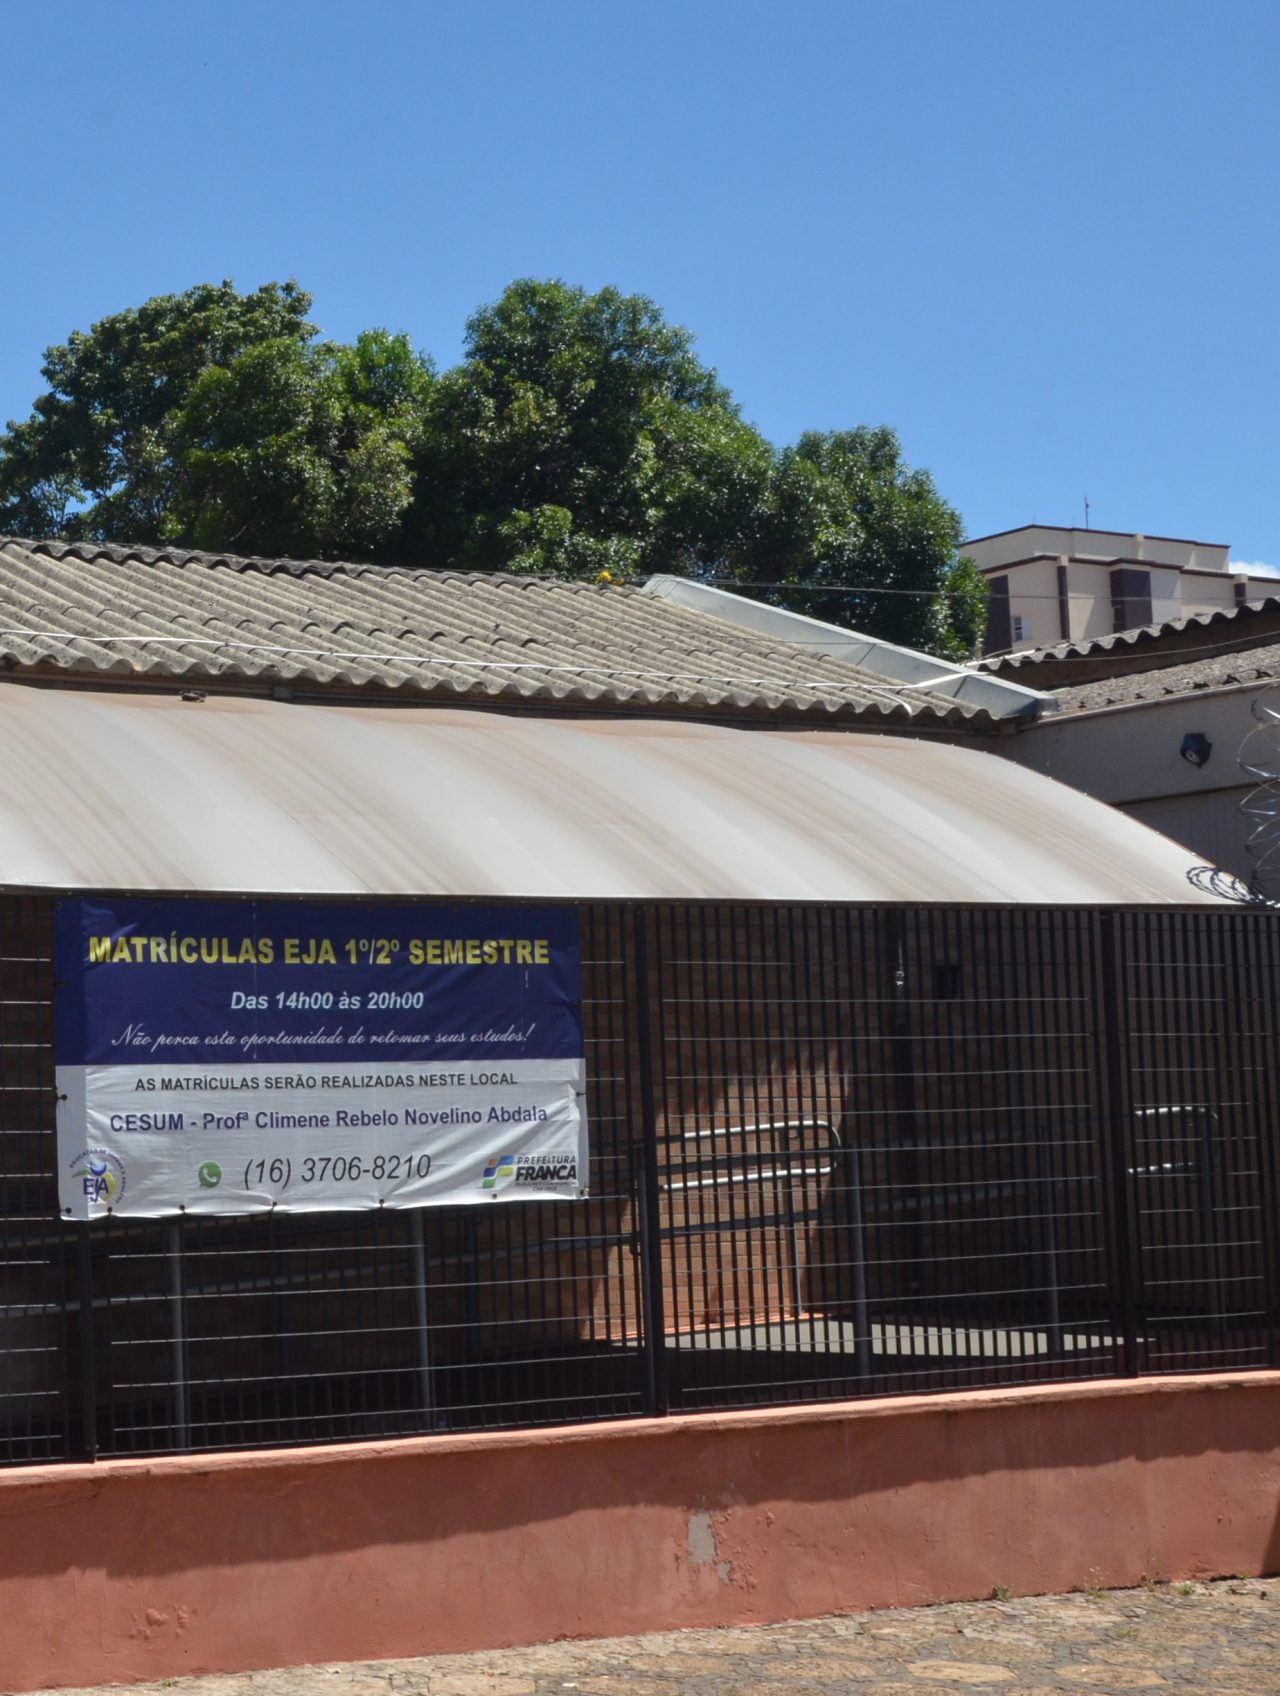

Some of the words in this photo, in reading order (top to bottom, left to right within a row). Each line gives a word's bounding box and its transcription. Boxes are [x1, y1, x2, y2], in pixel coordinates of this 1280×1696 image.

[88, 931, 275, 964] MATRÍCULAS
[285, 938, 336, 965] EJA
[408, 938, 550, 966] SEMESTRE
[230, 991, 269, 1010] Das
[275, 991, 334, 1010] 14h00
[338, 990, 361, 1010] às
[367, 991, 424, 1009] 20h00
[111, 1023, 152, 1047] Não
[151, 1033, 200, 1053] perca
[204, 1029, 236, 1046] esta
[240, 1026, 344, 1052] oportunidade
[347, 1027, 365, 1046] de
[369, 1029, 432, 1045] retomar
[434, 1032, 467, 1044] seus
[470, 1023, 536, 1043] estudos!
[134, 1077, 157, 1092] AS
[161, 1073, 260, 1092] MATRÍCULAS
[265, 1072, 317, 1090] SERÃO
[320, 1074, 415, 1089] REALIZADAS
[419, 1073, 465, 1087] NESTE
[470, 1071, 518, 1086] LOCAL
[110, 1112, 185, 1133] CESUM
[255, 1109, 330, 1129] Climene
[336, 1107, 399, 1127] Rebelo
[404, 1105, 482, 1126] Novelino
[487, 1103, 548, 1123] Abdala
[243, 1157, 292, 1190] (16)
[300, 1153, 432, 1184] 3706-8210
[517, 1155, 576, 1165] PREFEITURA
[515, 1165, 576, 1181] FRANCA
[83, 1178, 109, 1202] EJA
